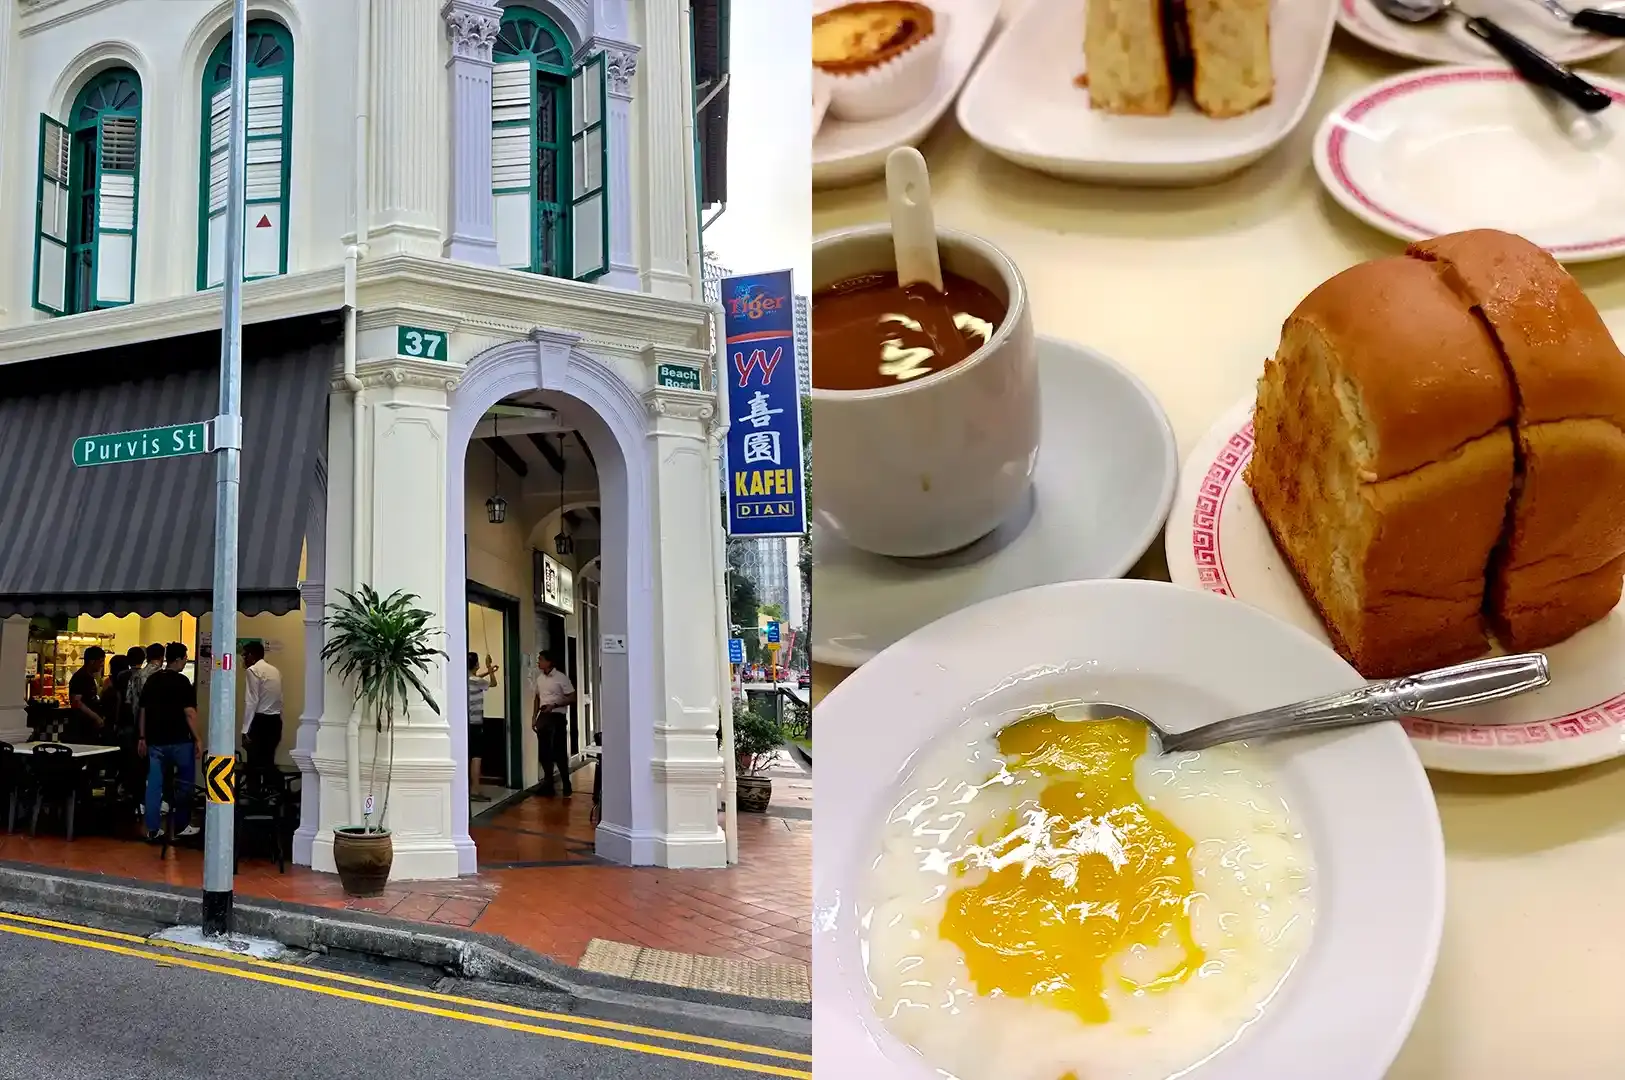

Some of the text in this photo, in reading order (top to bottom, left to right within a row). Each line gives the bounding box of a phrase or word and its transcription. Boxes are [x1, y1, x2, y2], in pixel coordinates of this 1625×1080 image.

[728, 293, 785, 319] Tiger
[405, 331, 441, 357] 37
[661, 366, 697, 380] Beach
[734, 346, 783, 388] YY
[665, 378, 694, 389] Road
[738, 390, 784, 465] 喜園
[84, 429, 197, 461] Purvis St
[735, 468, 794, 497] KAFEI
[741, 503, 791, 516] DIAN
